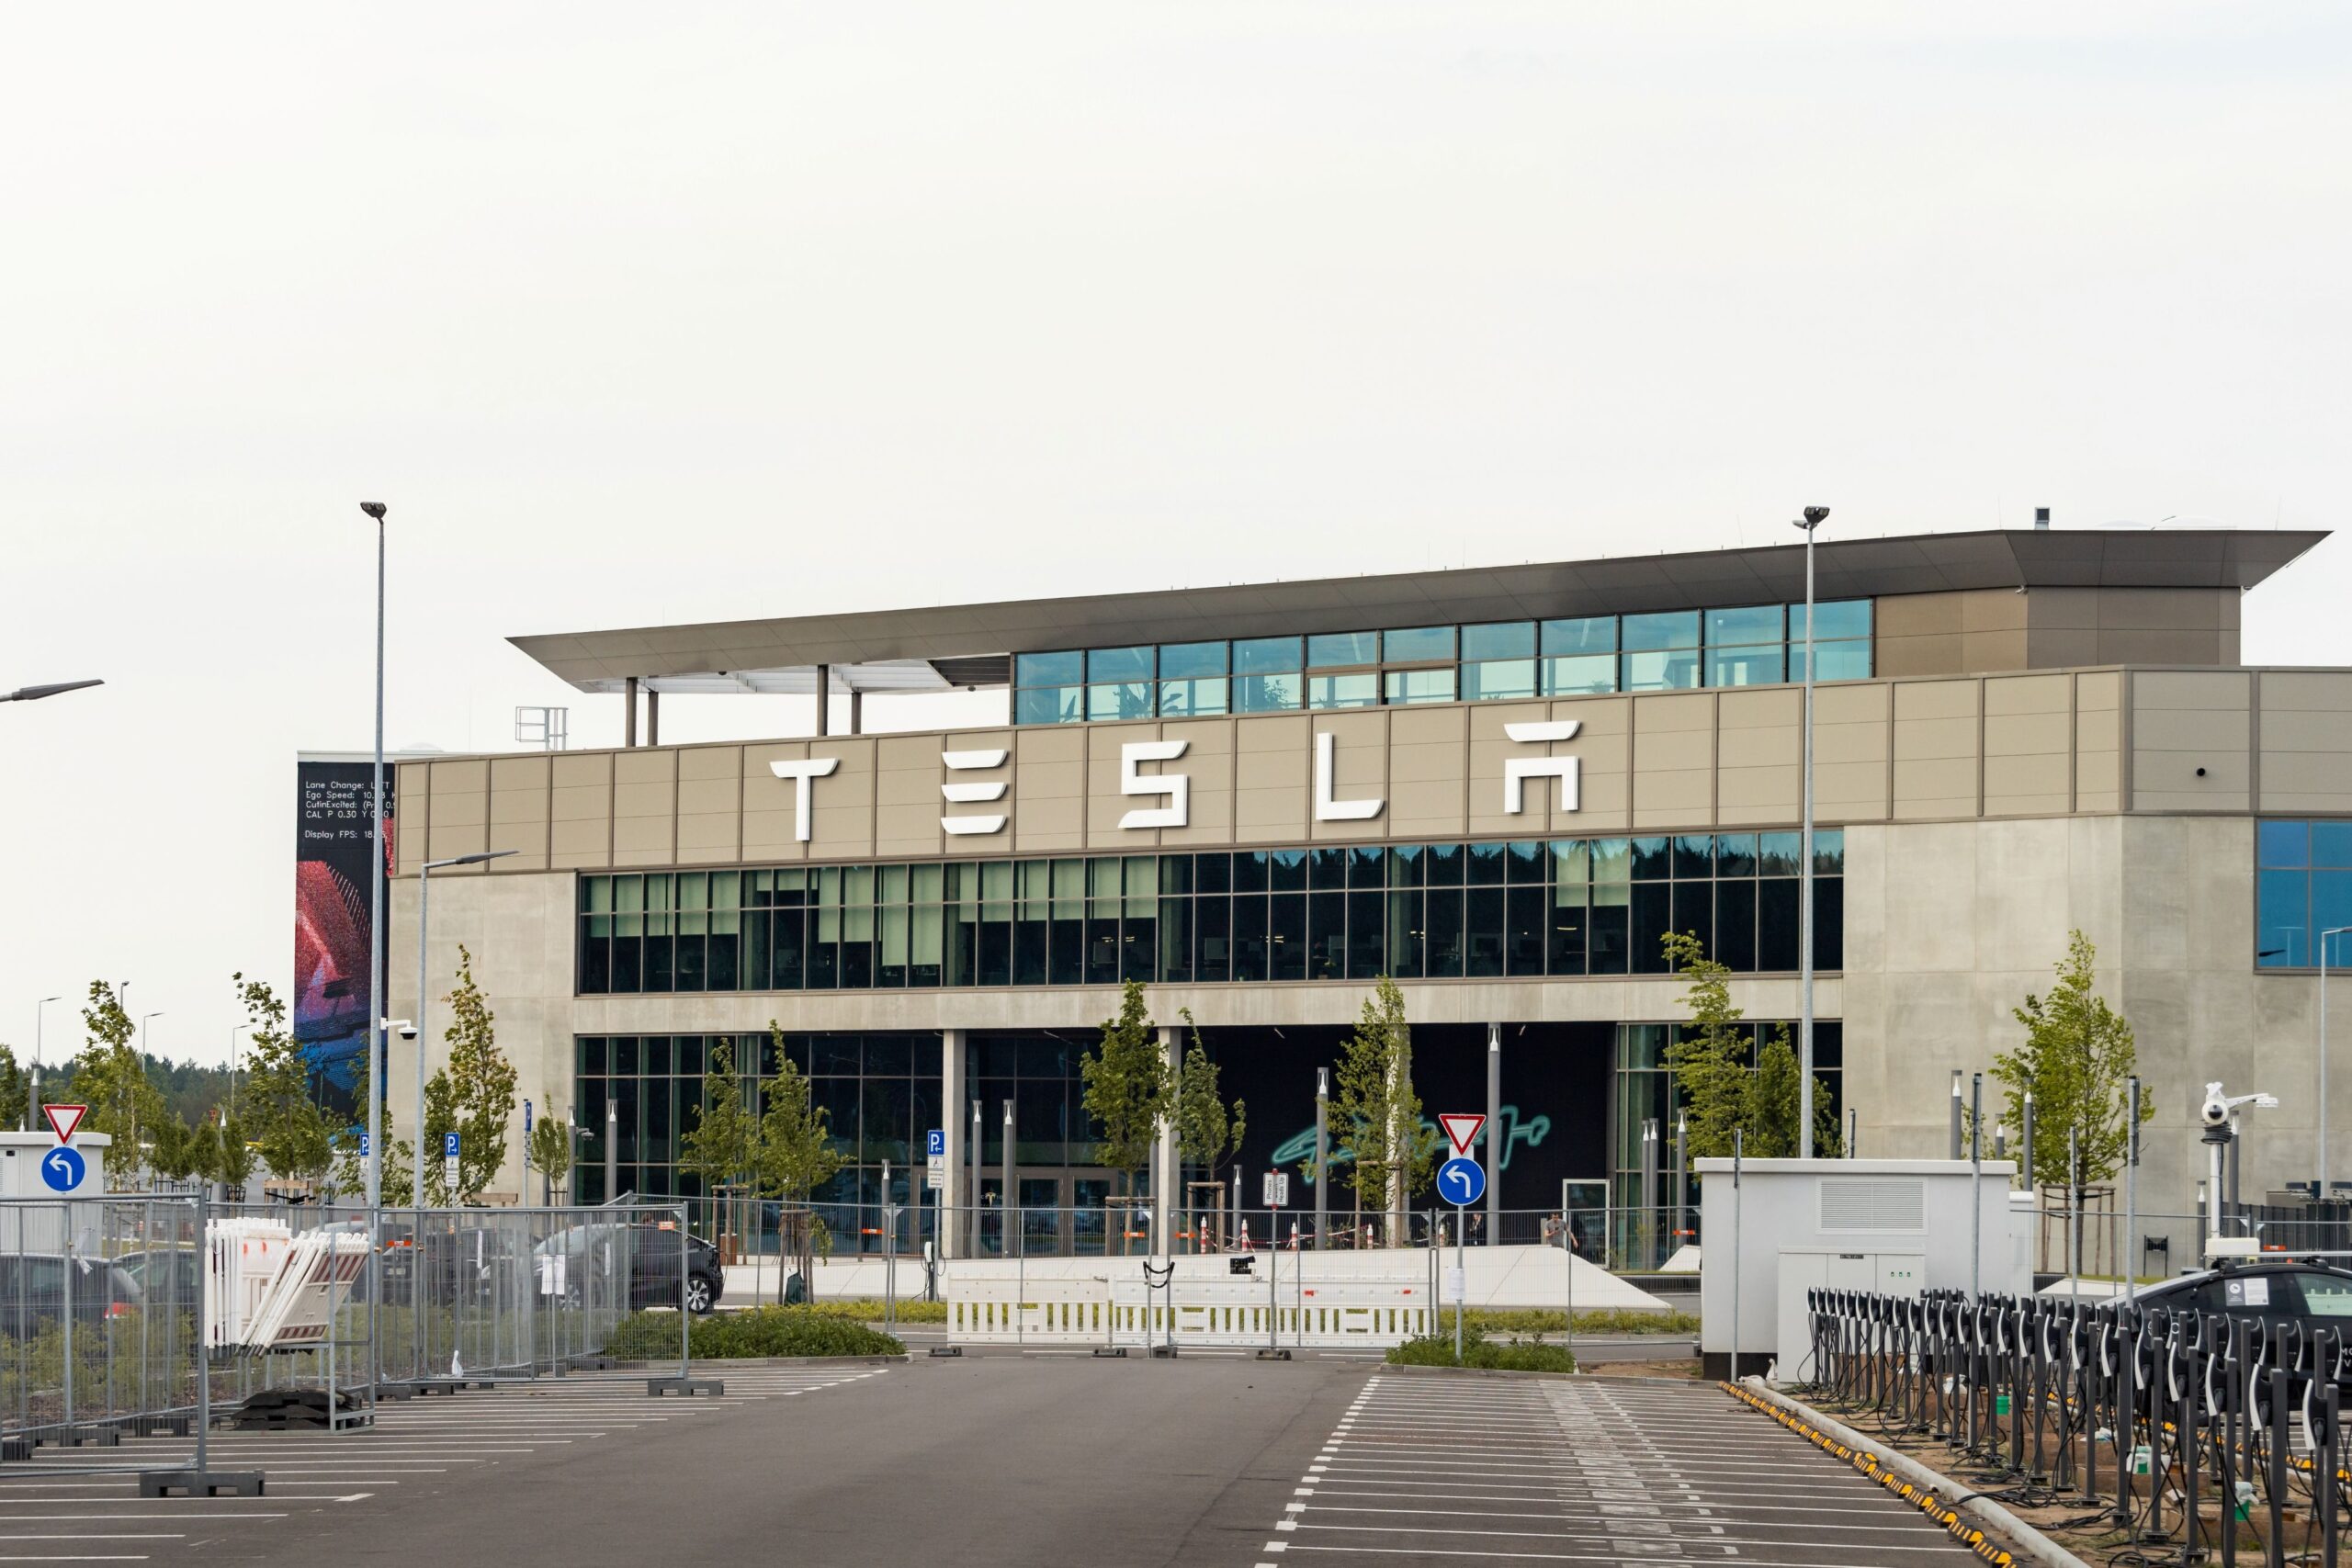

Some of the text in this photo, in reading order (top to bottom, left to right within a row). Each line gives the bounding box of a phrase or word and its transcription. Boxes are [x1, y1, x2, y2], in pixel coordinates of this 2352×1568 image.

[330, 781, 364, 791] Change:
[770, 720, 1579, 842] TESLA
[306, 791, 321, 800] Ego
[327, 791, 355, 800] Speed:
[305, 831, 334, 840] Display
[447, 1136, 456, 1153] P
[931, 1134, 940, 1152] P
